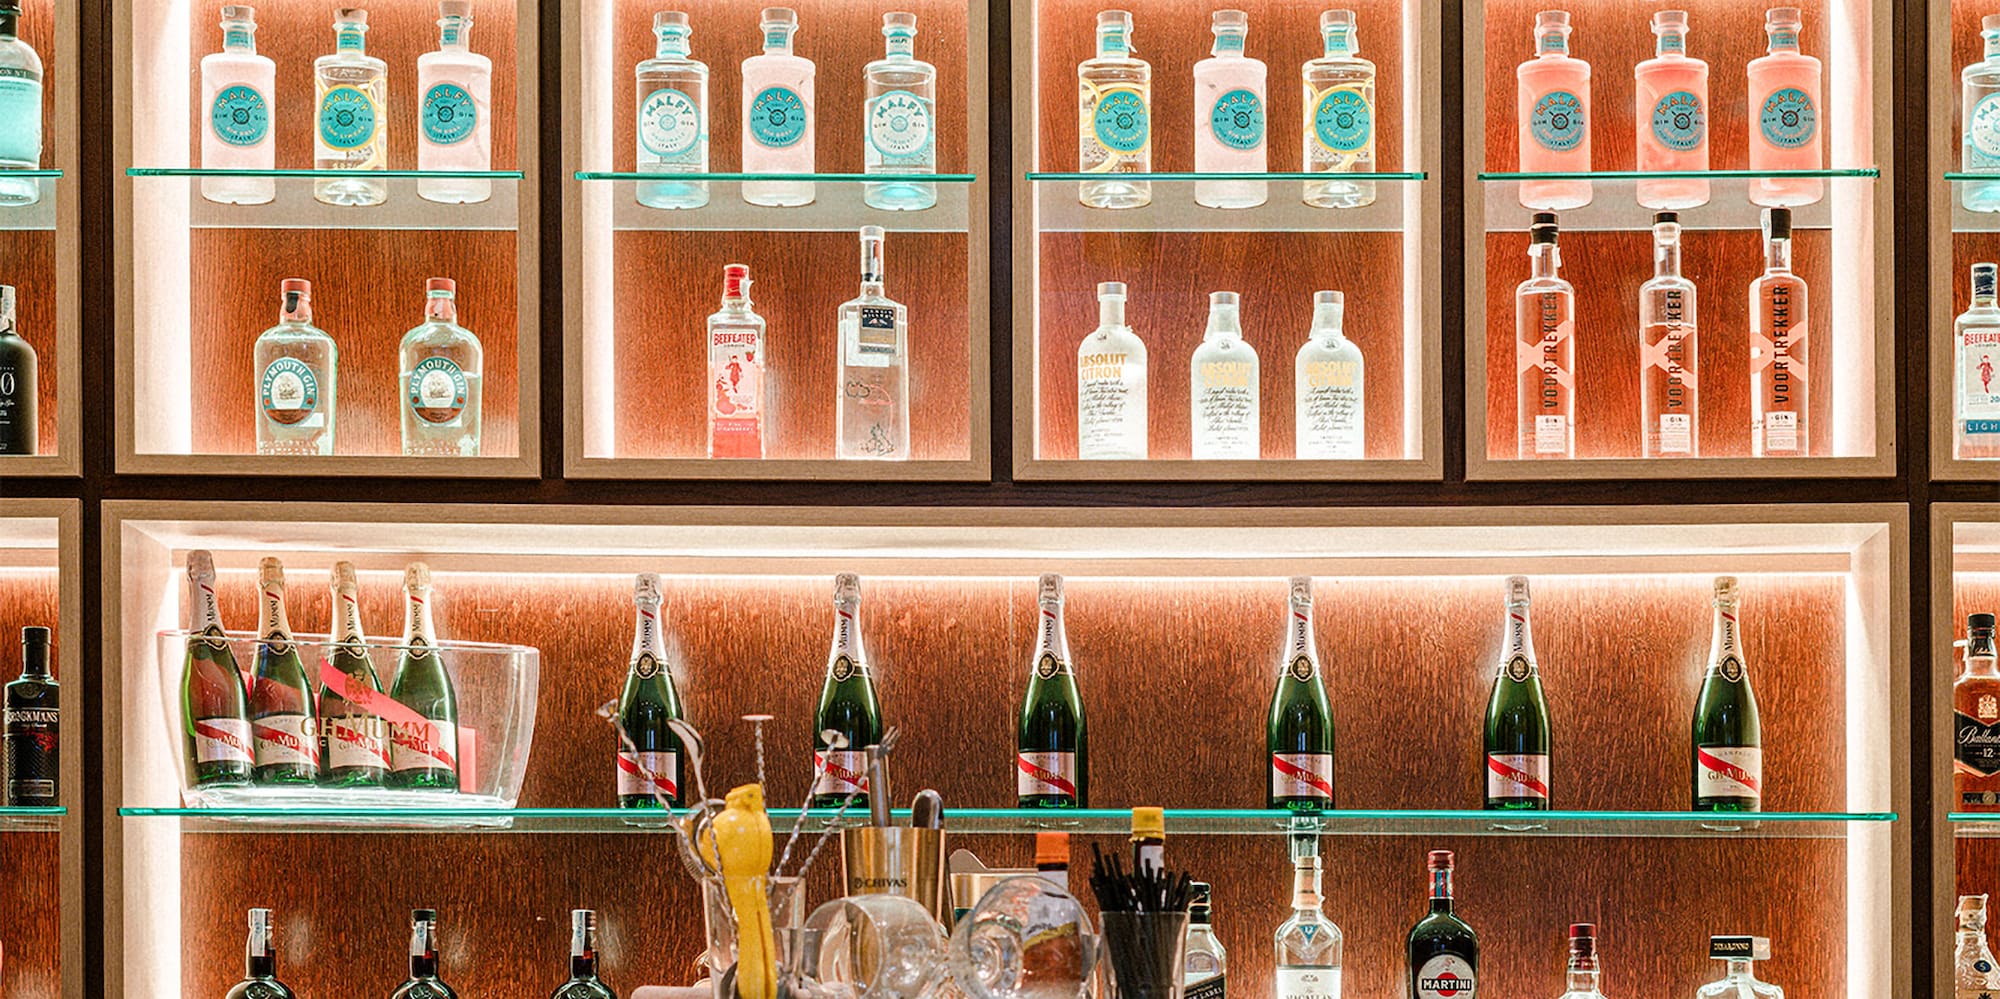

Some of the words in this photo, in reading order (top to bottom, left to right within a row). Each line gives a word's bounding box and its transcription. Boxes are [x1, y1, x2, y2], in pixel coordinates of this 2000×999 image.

[217, 89, 265, 109] MALFY
[322, 91, 369, 112] MALFY
[425, 87, 472, 108] MALFY
[646, 95, 693, 117] MALFY
[754, 90, 801, 111] MALFY
[876, 96, 923, 118] MALFY
[1100, 95, 1145, 115] MALFY
[1216, 93, 1262, 114] MALFY
[1320, 94, 1367, 115] MALFY
[1536, 94, 1583, 117] MALFY
[1656, 95, 1704, 117] MALFY
[1765, 91, 1813, 114] MALFY
[714, 333, 756, 346] BEEFEATER
[1543, 291, 1557, 408] VOORTREKKER
[1667, 290, 1682, 407] VOORTREKKER
[1773, 286, 1789, 404] VOORTREKKER
[263, 361, 306, 395] PLYMOUTH
[303, 374, 316, 395] GIN
[410, 359, 455, 394] PLYMOUTH
[454, 374, 466, 394] GIN
[1082, 366, 1121, 380] CITRON
[1200, 361, 1252, 376] ABSOLUT
[1305, 361, 1357, 376] ABSOLUT
[865, 878, 908, 889] CHIVAS
[1423, 979, 1471, 990] MARTINI
